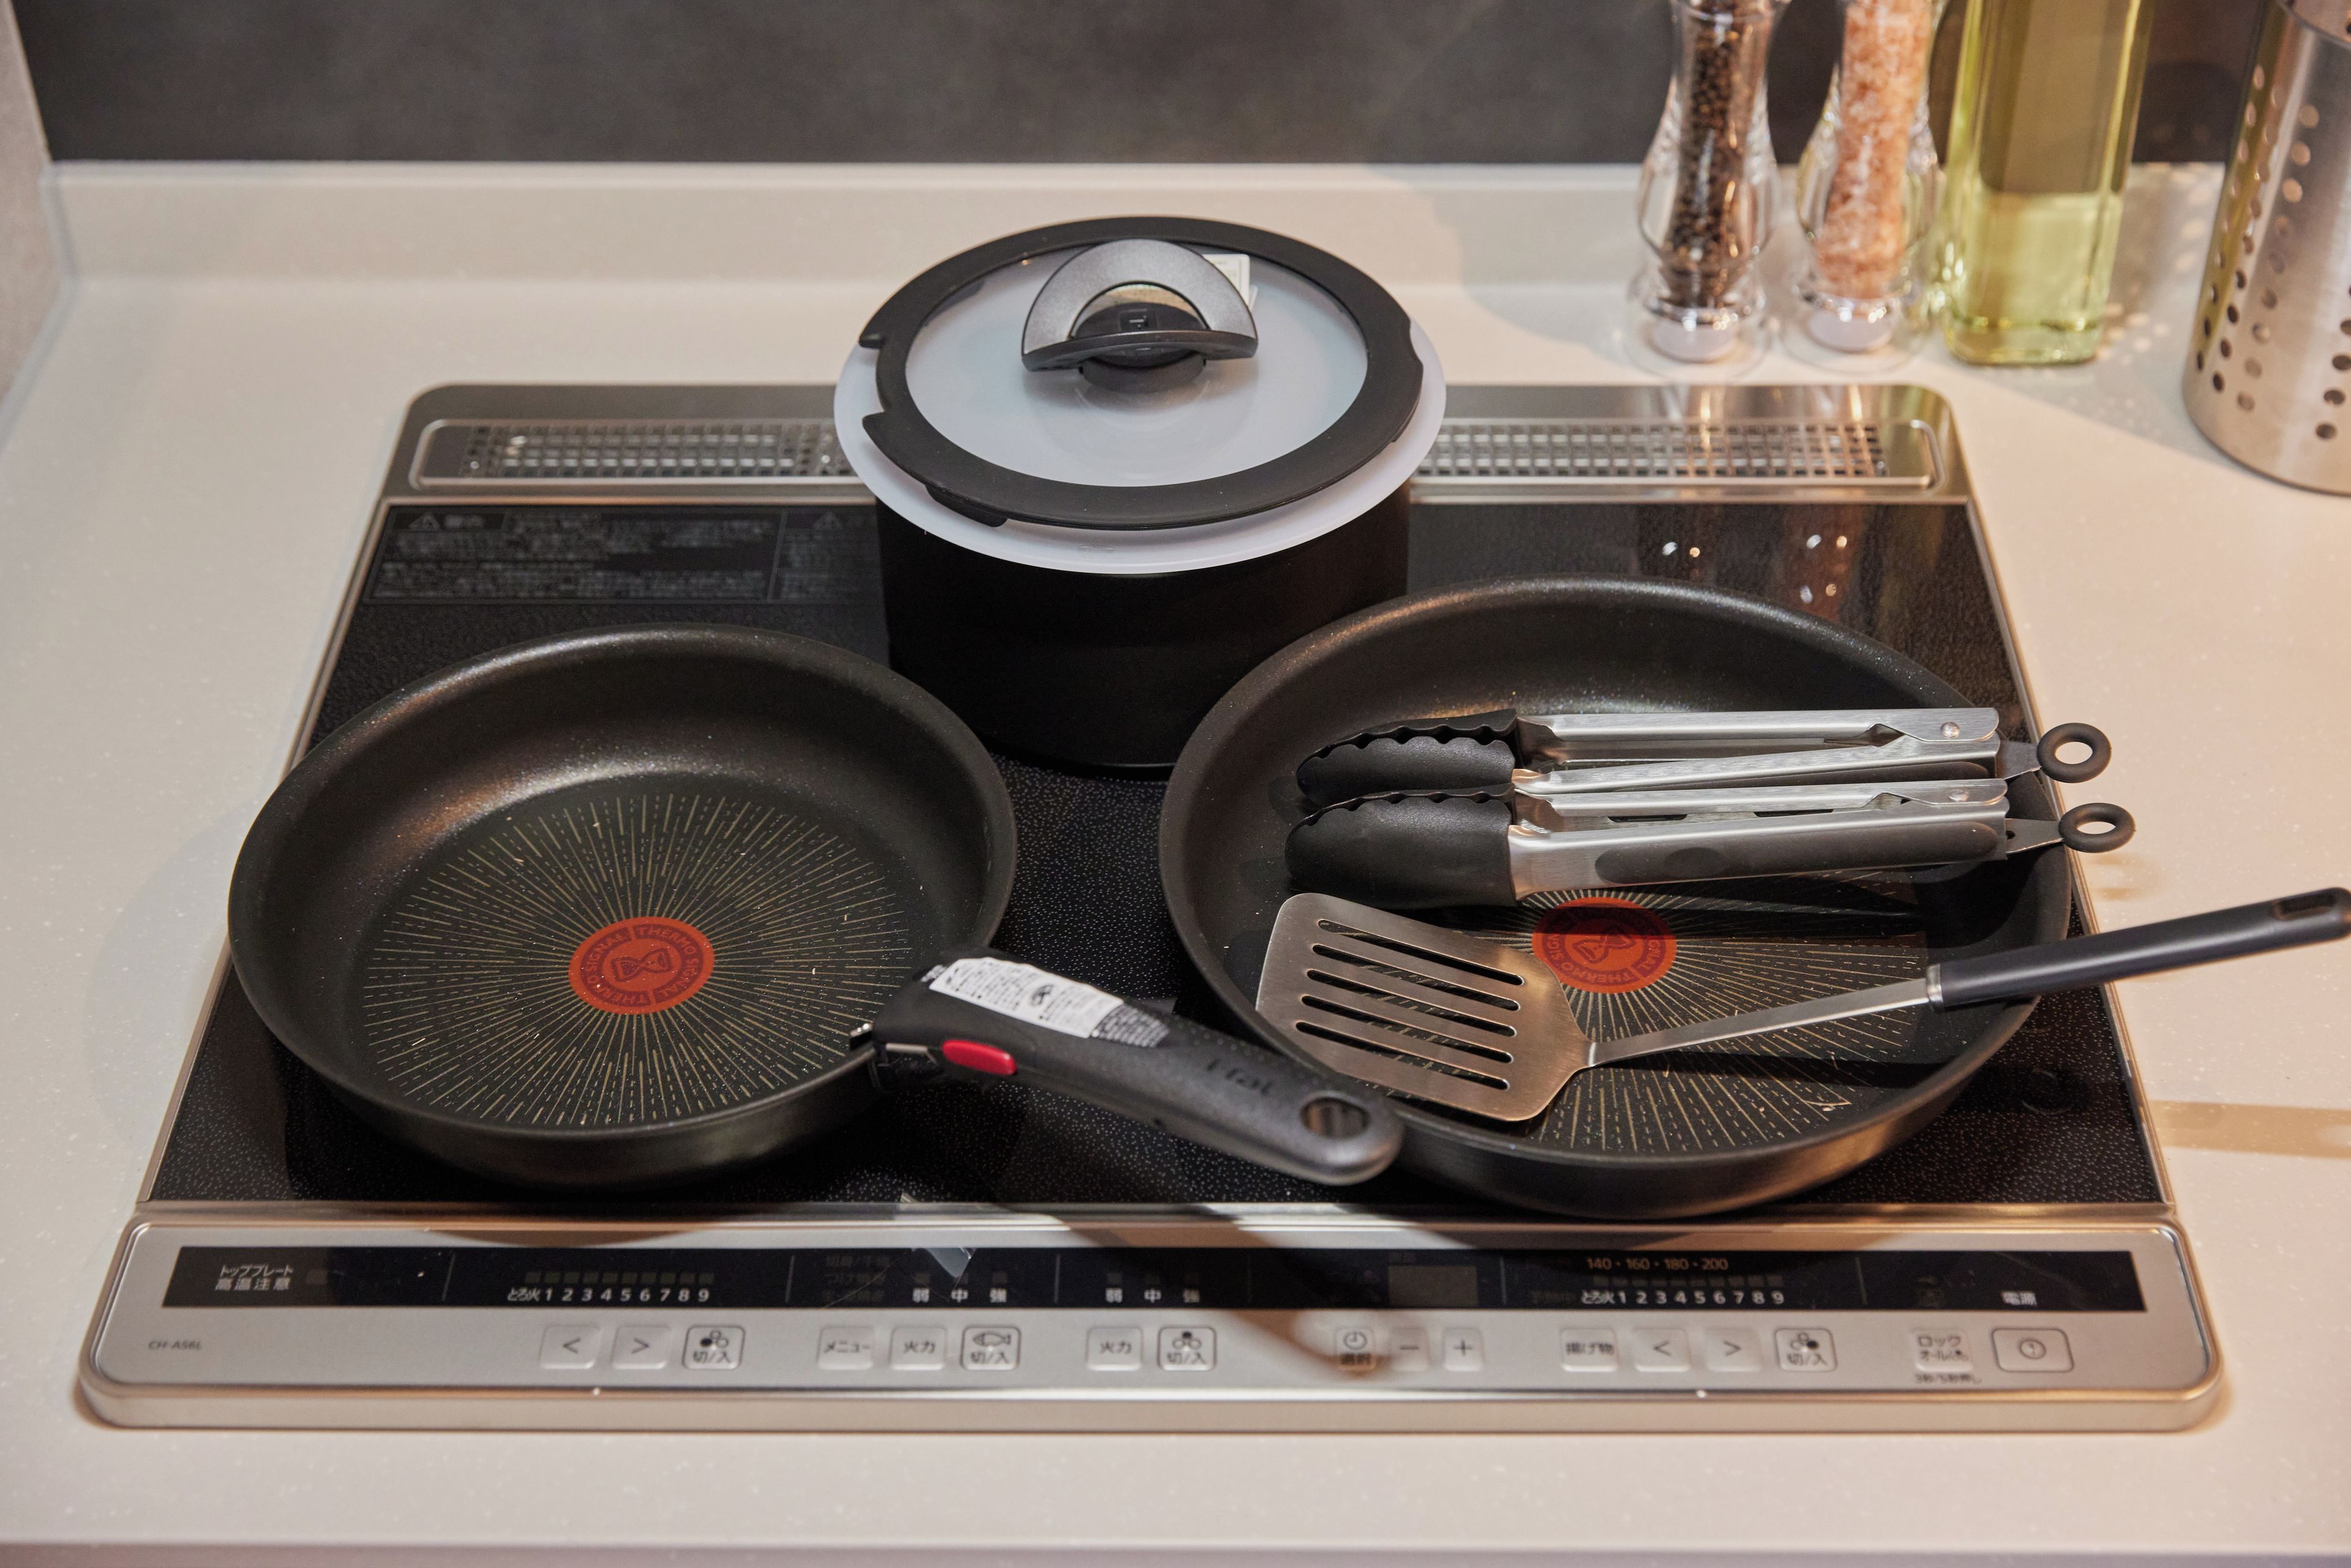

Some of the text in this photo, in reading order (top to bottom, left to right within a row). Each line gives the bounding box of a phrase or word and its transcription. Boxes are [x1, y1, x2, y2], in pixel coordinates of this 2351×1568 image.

[585, 932, 624, 972] SIGNAL
[636, 926, 700, 1000] THERMO SIGNAL
[1561, 962, 1635, 984] THERMO
[1587, 1257, 1728, 1270] 140 160 180 200
[219, 1264, 294, 1278] トッププレート
[216, 1278, 291, 1291] 高温注意
[545, 1288, 553, 1302] 1
[561, 1288, 574, 1302] 2
[582, 1288, 593, 1302] 3
[600, 1288, 612, 1302] 4
[620, 1288, 632, 1302] 5
[639, 1288, 651, 1302] 6
[660, 1288, 672, 1302] 7
[678, 1288, 690, 1302] 8
[697, 1288, 710, 1302] 9
[951, 1288, 969, 1303] 中
[1144, 1288, 1161, 1303] 中
[1618, 1289, 1626, 1304] 1
[1636, 1289, 1648, 1304] 2
[1655, 1289, 1667, 1304] 3
[1674, 1289, 1687, 1304] 4
[1693, 1289, 1706, 1304] 5
[1714, 1289, 1726, 1304] 6
[1733, 1289, 1744, 1304] 7
[1752, 1289, 1764, 1304] 8
[1772, 1289, 1784, 1304] 9
[823, 1340, 870, 1354] メニュー
[903, 1340, 936, 1354] 火力
[1100, 1340, 1132, 1354] 火力
[1918, 1335, 1961, 1347] ロック
[970, 1351, 1010, 1364] 切/入
[1166, 1351, 1206, 1365] 切/入
[1787, 1352, 1827, 1366] 切/入
